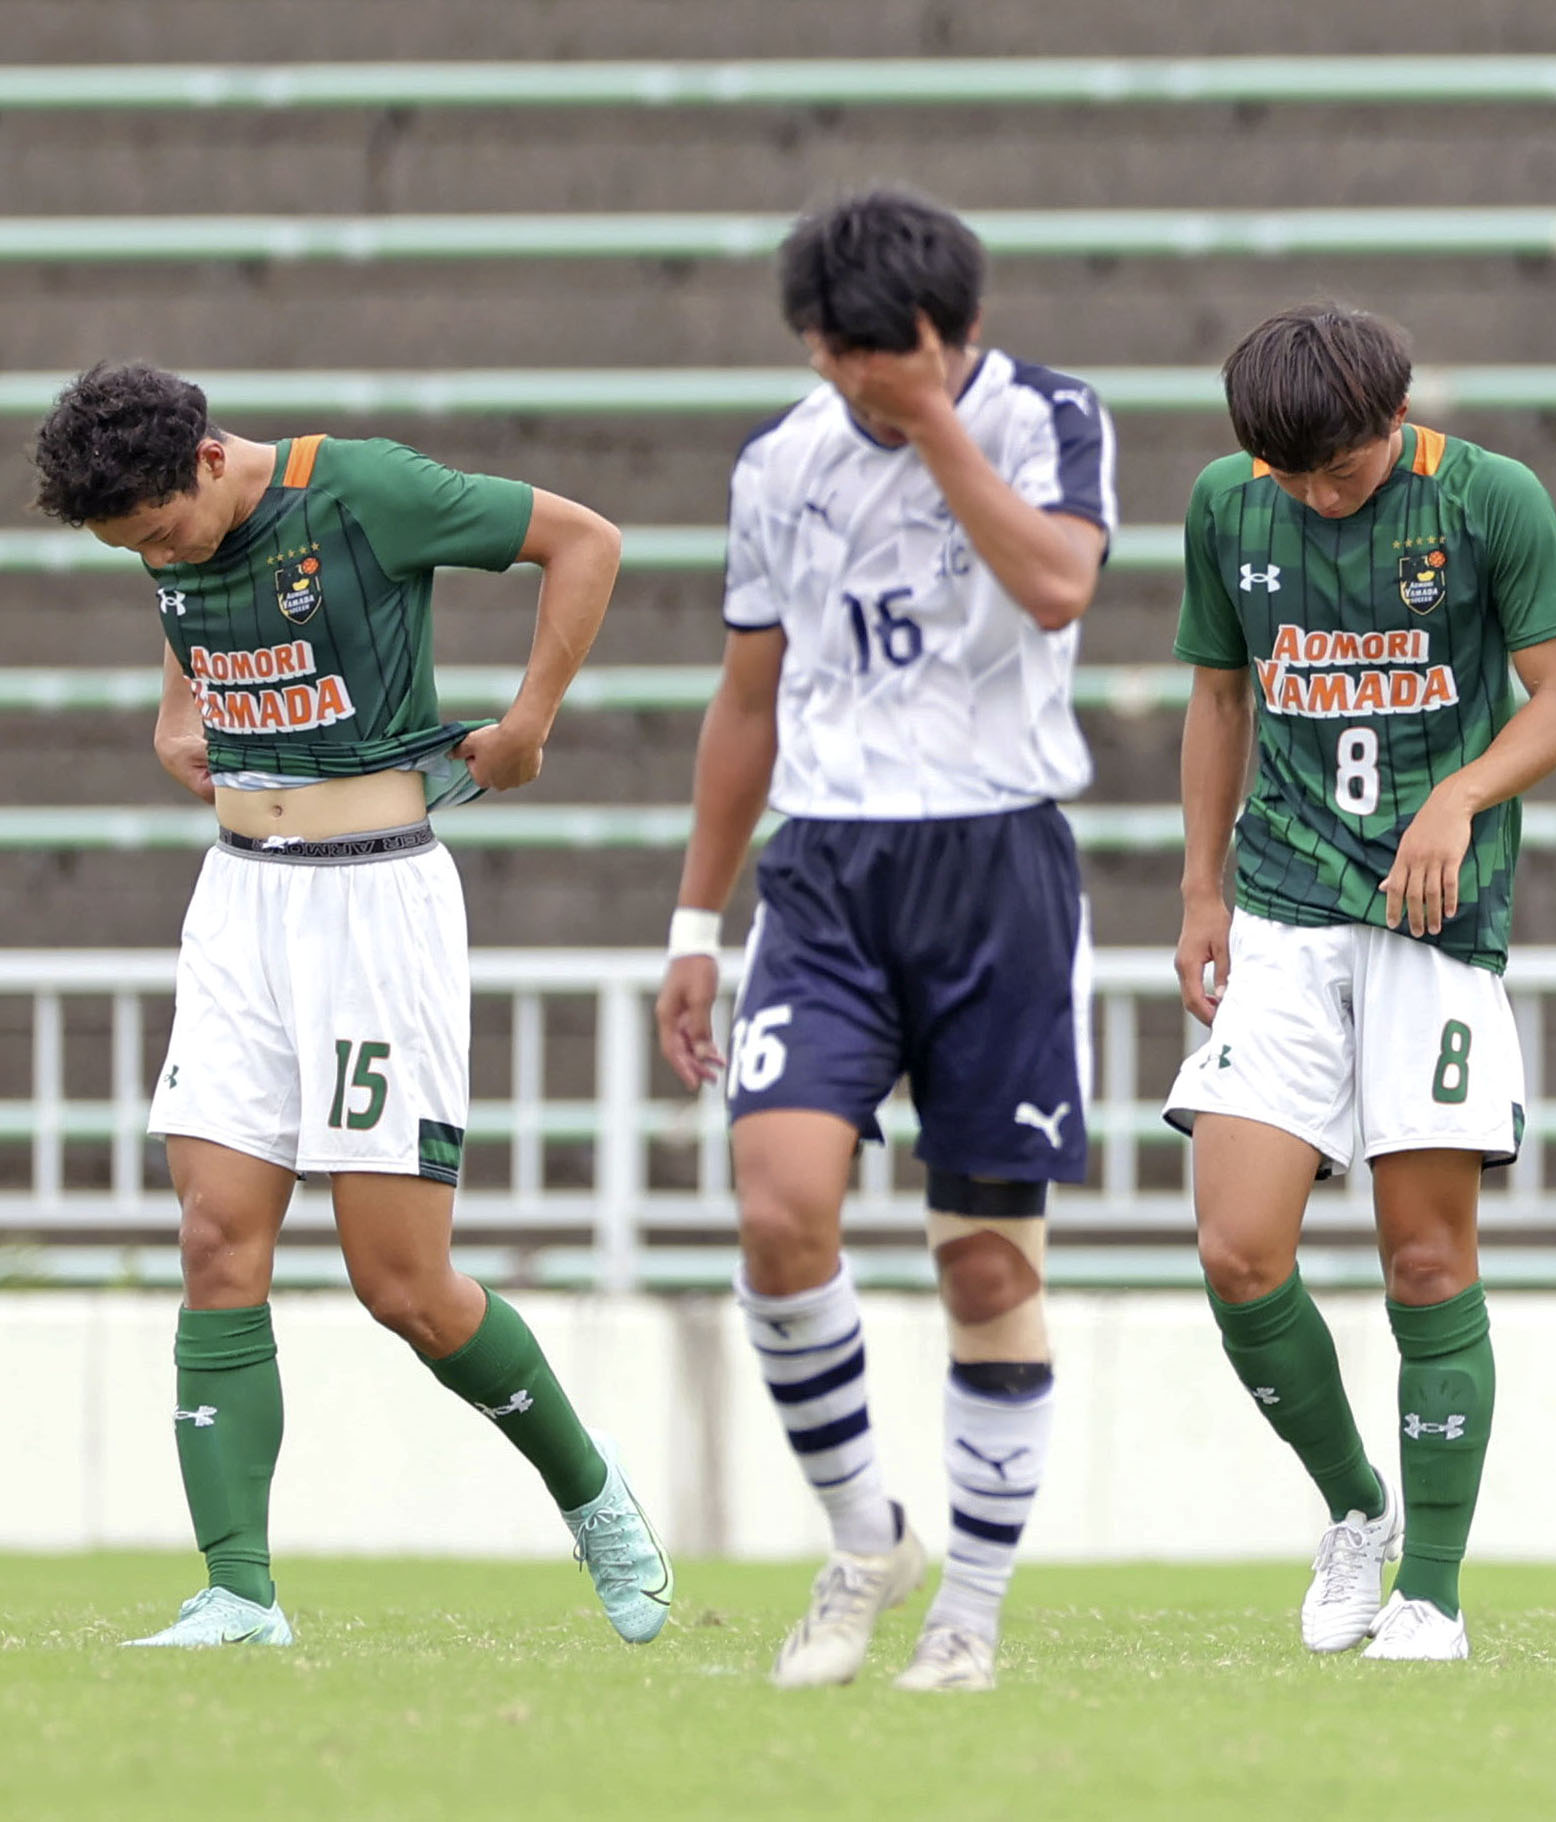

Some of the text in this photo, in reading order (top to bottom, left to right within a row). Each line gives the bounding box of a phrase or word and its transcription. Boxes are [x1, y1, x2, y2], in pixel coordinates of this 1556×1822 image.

[190, 639, 317, 687] AOMORI
[841, 587, 924, 675] 16
[1271, 624, 1430, 668] AOMORI
[1253, 656, 1460, 719] YAMADA
[1334, 726, 1380, 816] 8
[328, 1038, 391, 1132] 15
[727, 1004, 792, 1099] 16
[1431, 1018, 1472, 1104] 8
